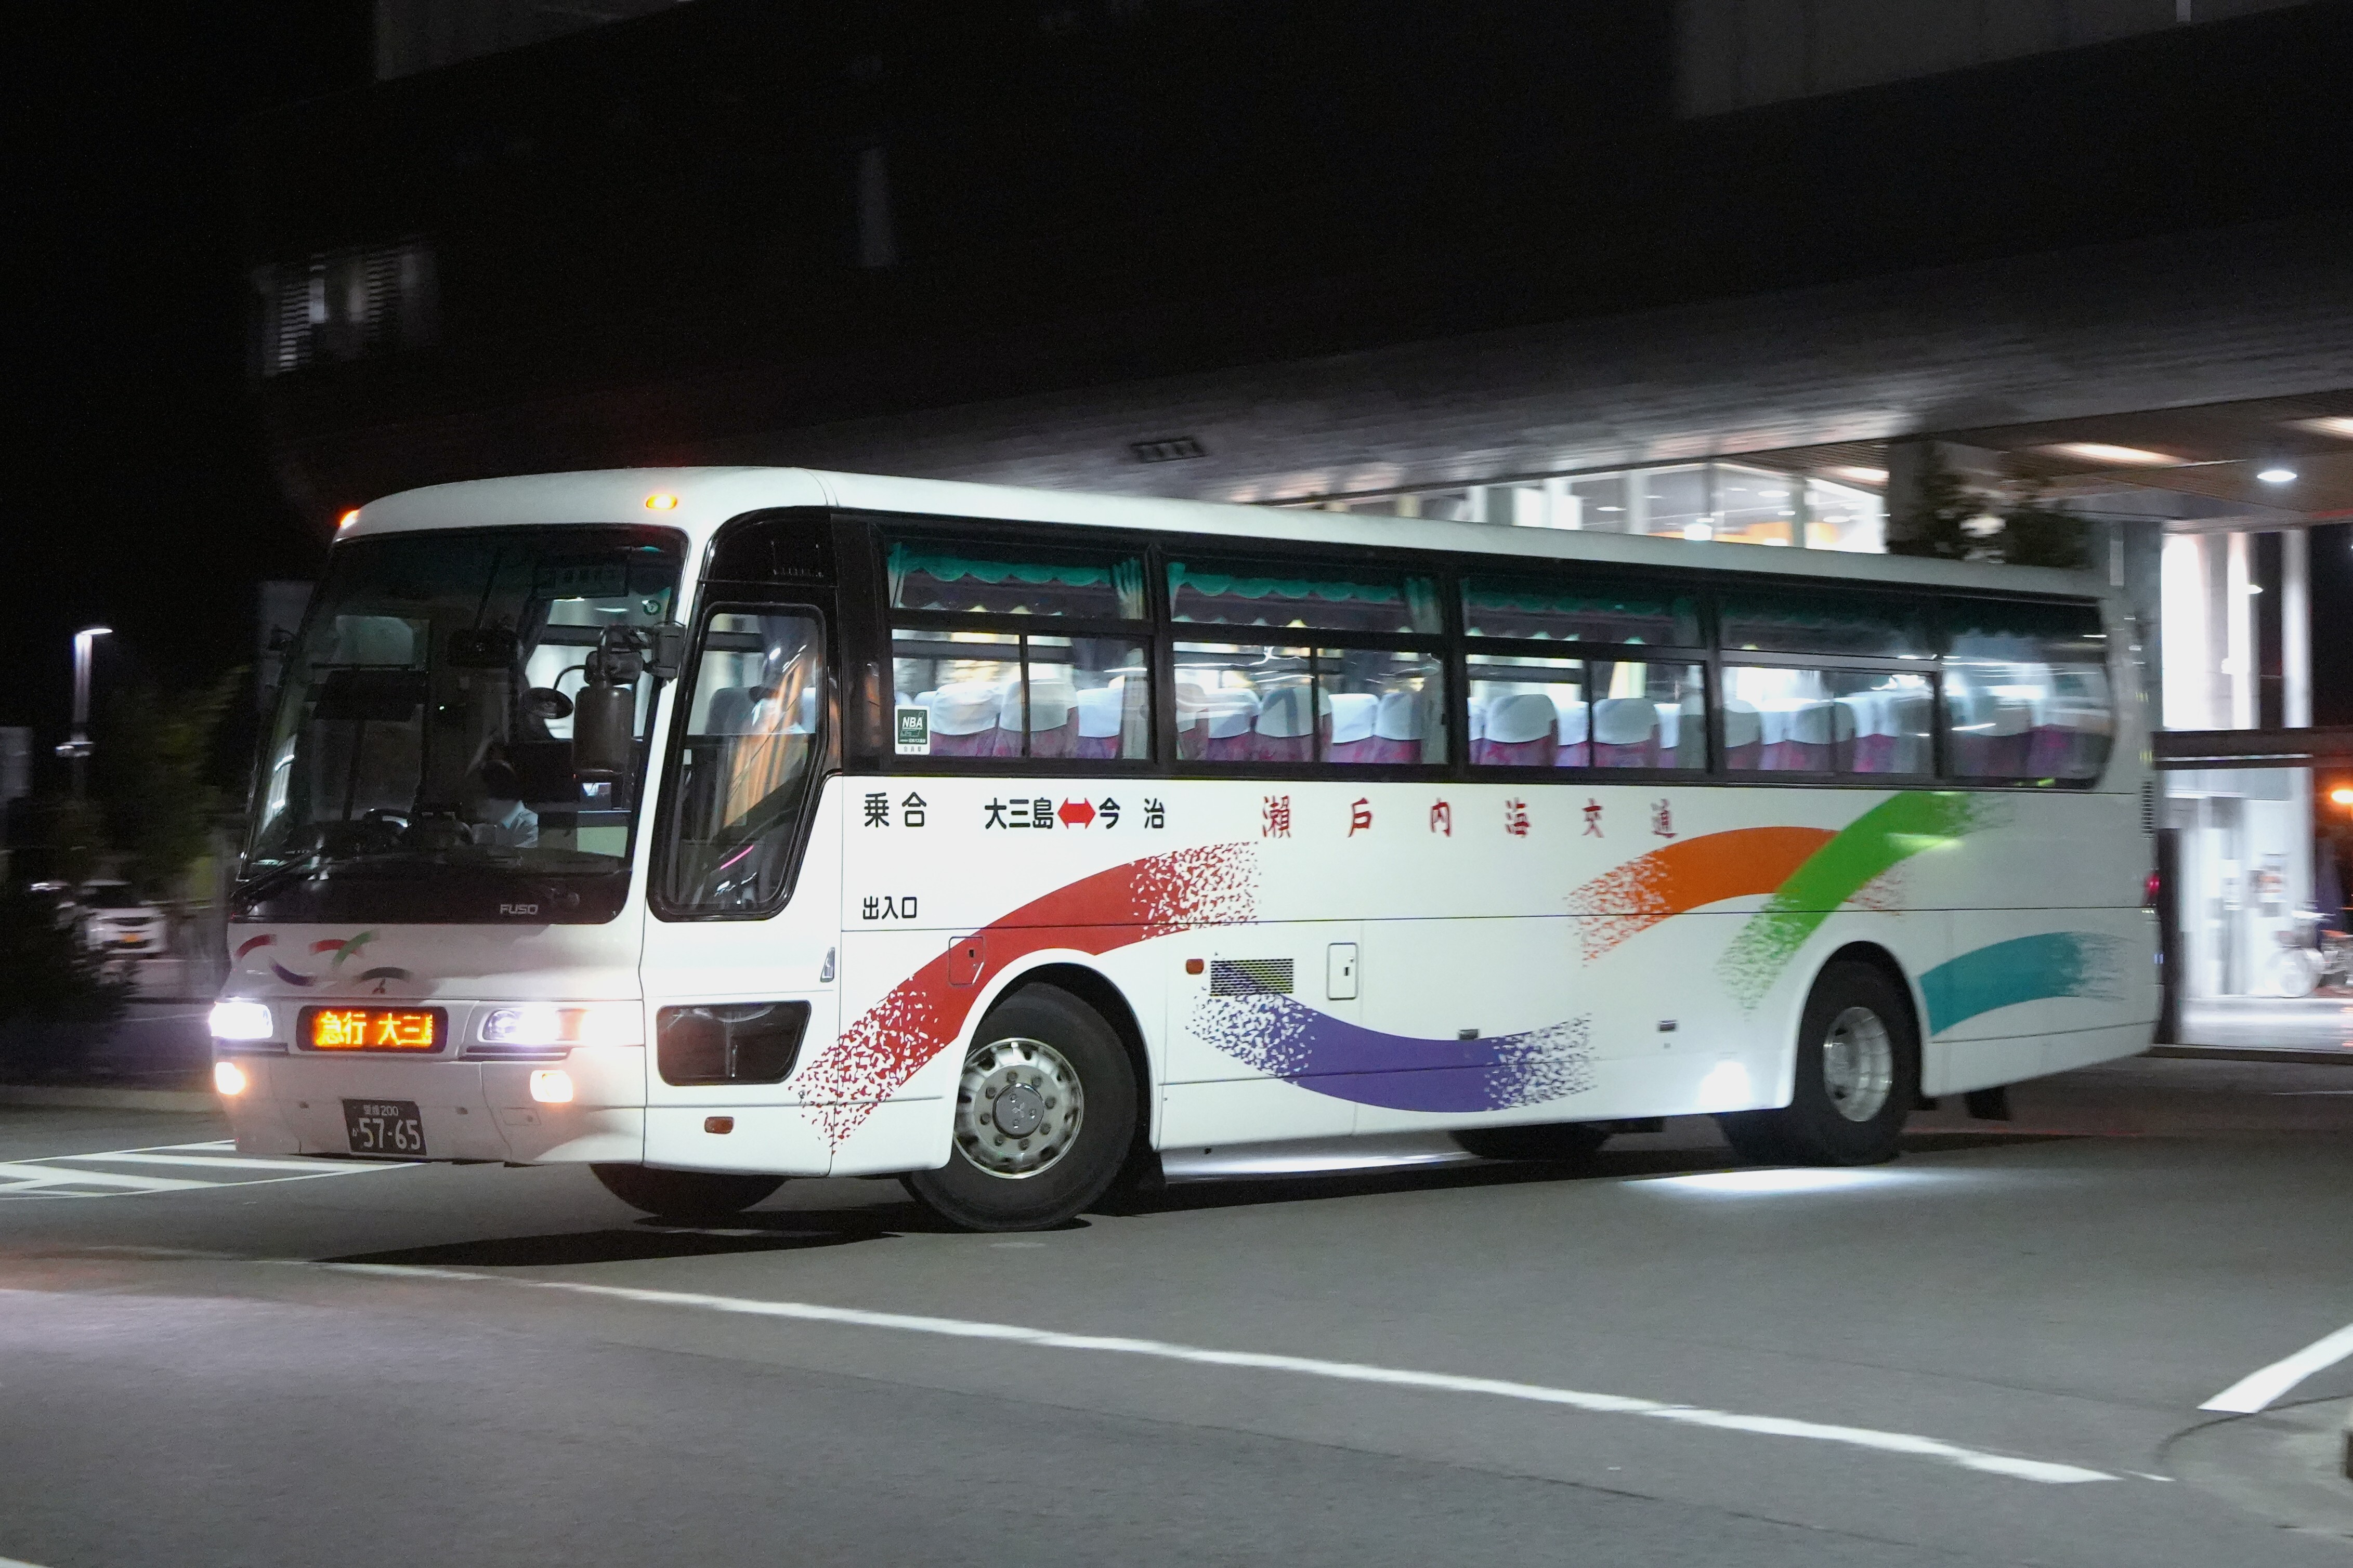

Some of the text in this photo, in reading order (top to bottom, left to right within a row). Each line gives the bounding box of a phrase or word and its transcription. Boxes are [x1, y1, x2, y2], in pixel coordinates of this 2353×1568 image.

[902, 717, 923, 728] NBA
[864, 792, 927, 828] 乗合
[985, 797, 1165, 830] 大三島 今治
[500, 904, 539, 915] FUSO
[862, 895, 918, 920] 出入口
[316, 1011, 367, 1046] 急行
[381, 1105, 399, 1116] 200
[359, 1117, 421, 1150] 57-65
